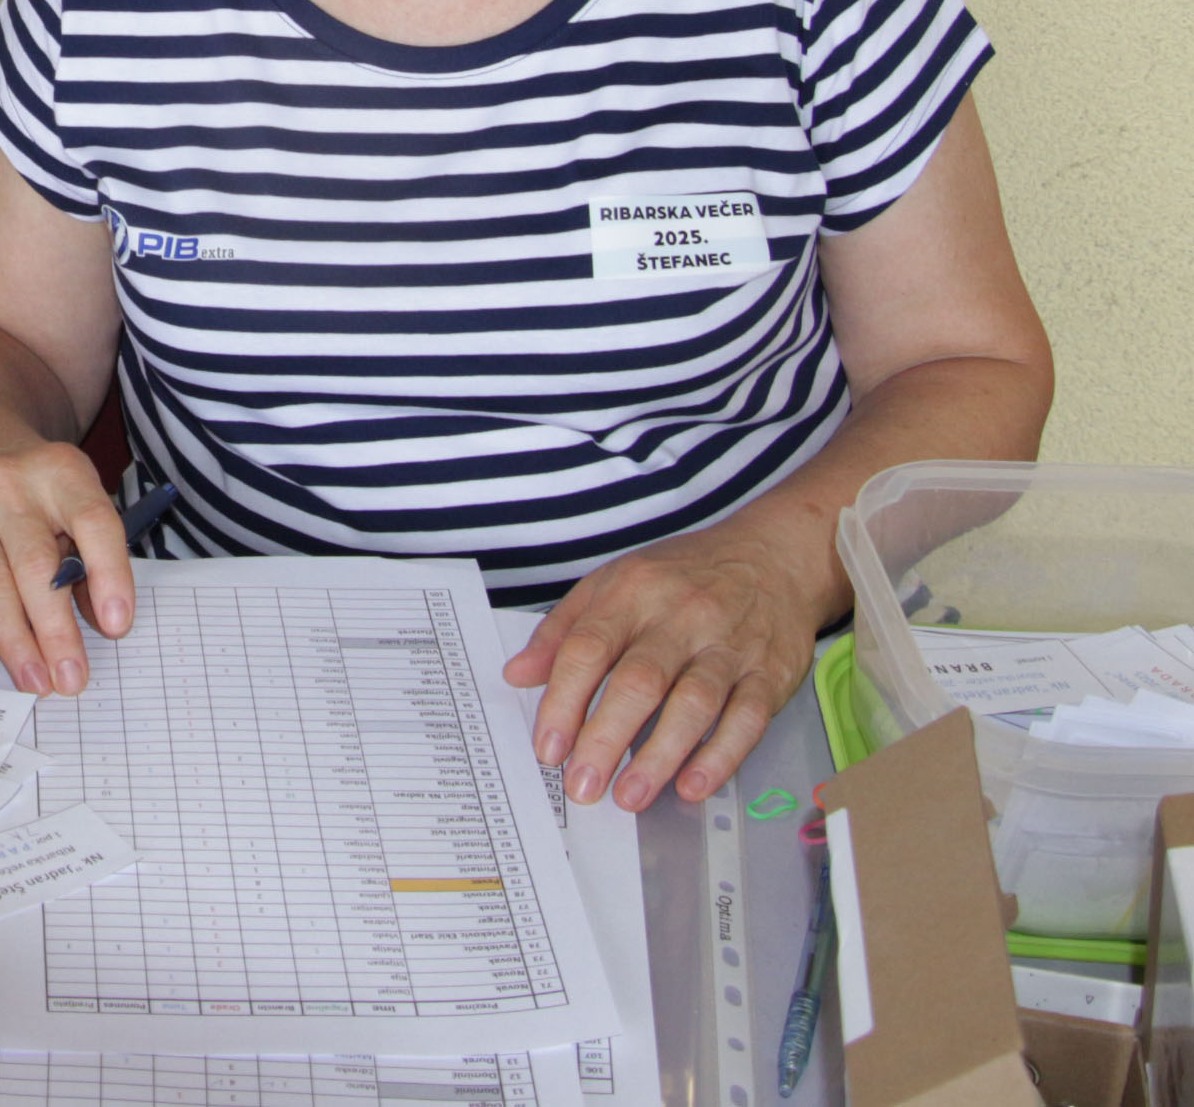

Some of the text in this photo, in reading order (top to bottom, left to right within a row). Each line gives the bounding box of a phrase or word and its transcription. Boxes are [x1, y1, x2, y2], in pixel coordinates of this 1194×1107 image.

[600, 200, 755, 221] RIBARSKA VEČER
[654, 229, 709, 246] 2025.
[138, 233, 235, 259] PIB extra
[637, 252, 732, 271] ŠTEFANEC
[81, 852, 104, 866] Nk
[714, 894, 733, 943] Optima
[492, 970, 525, 978] Novak
[496, 983, 528, 992] Novak
[372, 1005, 395, 1013] Ime
[456, 1003, 498, 1011] Prezime
